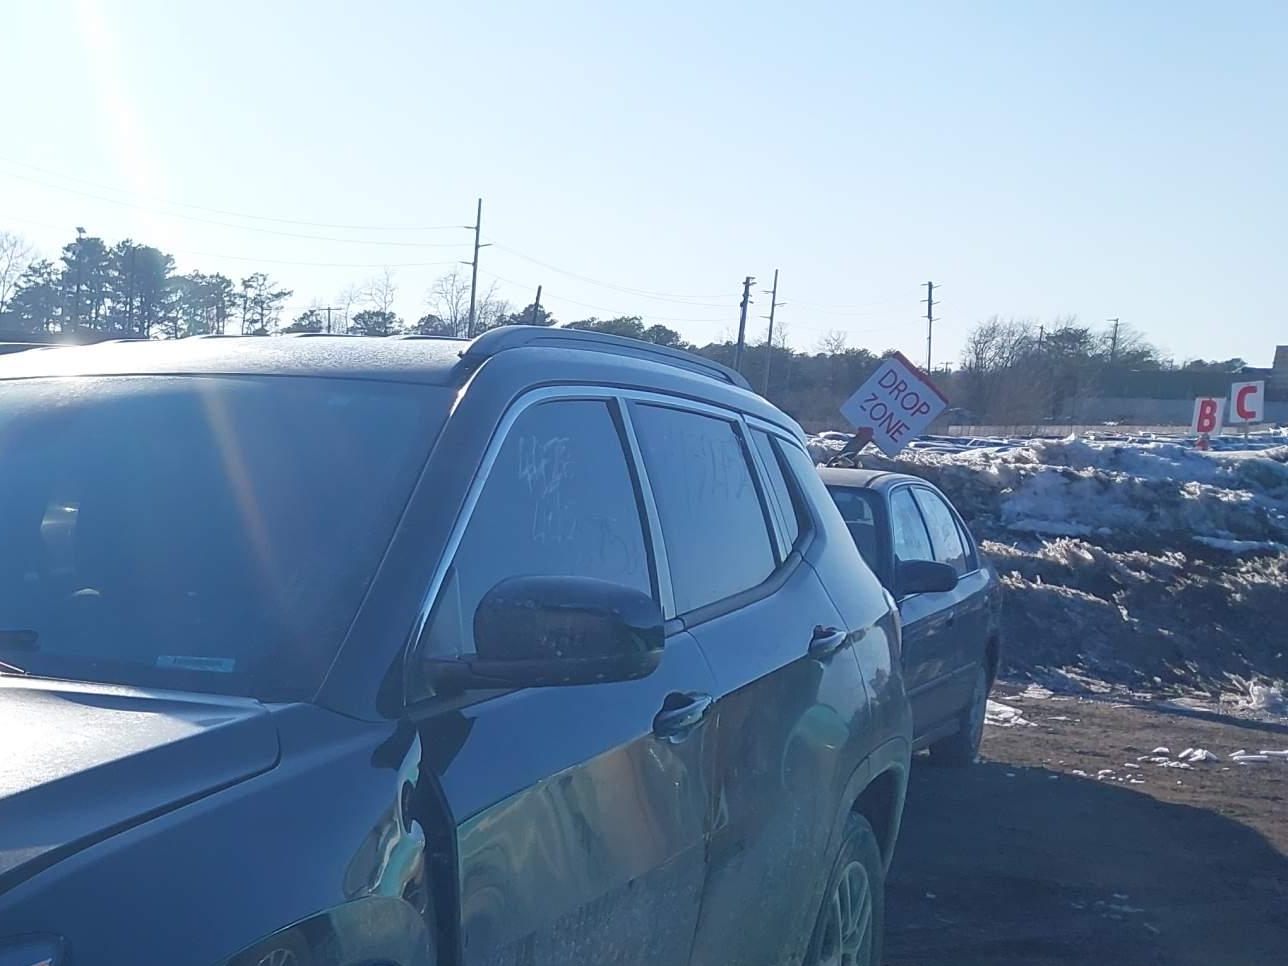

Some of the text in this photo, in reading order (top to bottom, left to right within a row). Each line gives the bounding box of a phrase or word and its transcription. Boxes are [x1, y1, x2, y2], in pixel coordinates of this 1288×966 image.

[878, 369, 930, 416] DROP
[1237, 385, 1258, 419] C
[859, 393, 910, 443] ZONE
[1197, 400, 1218, 433] B
